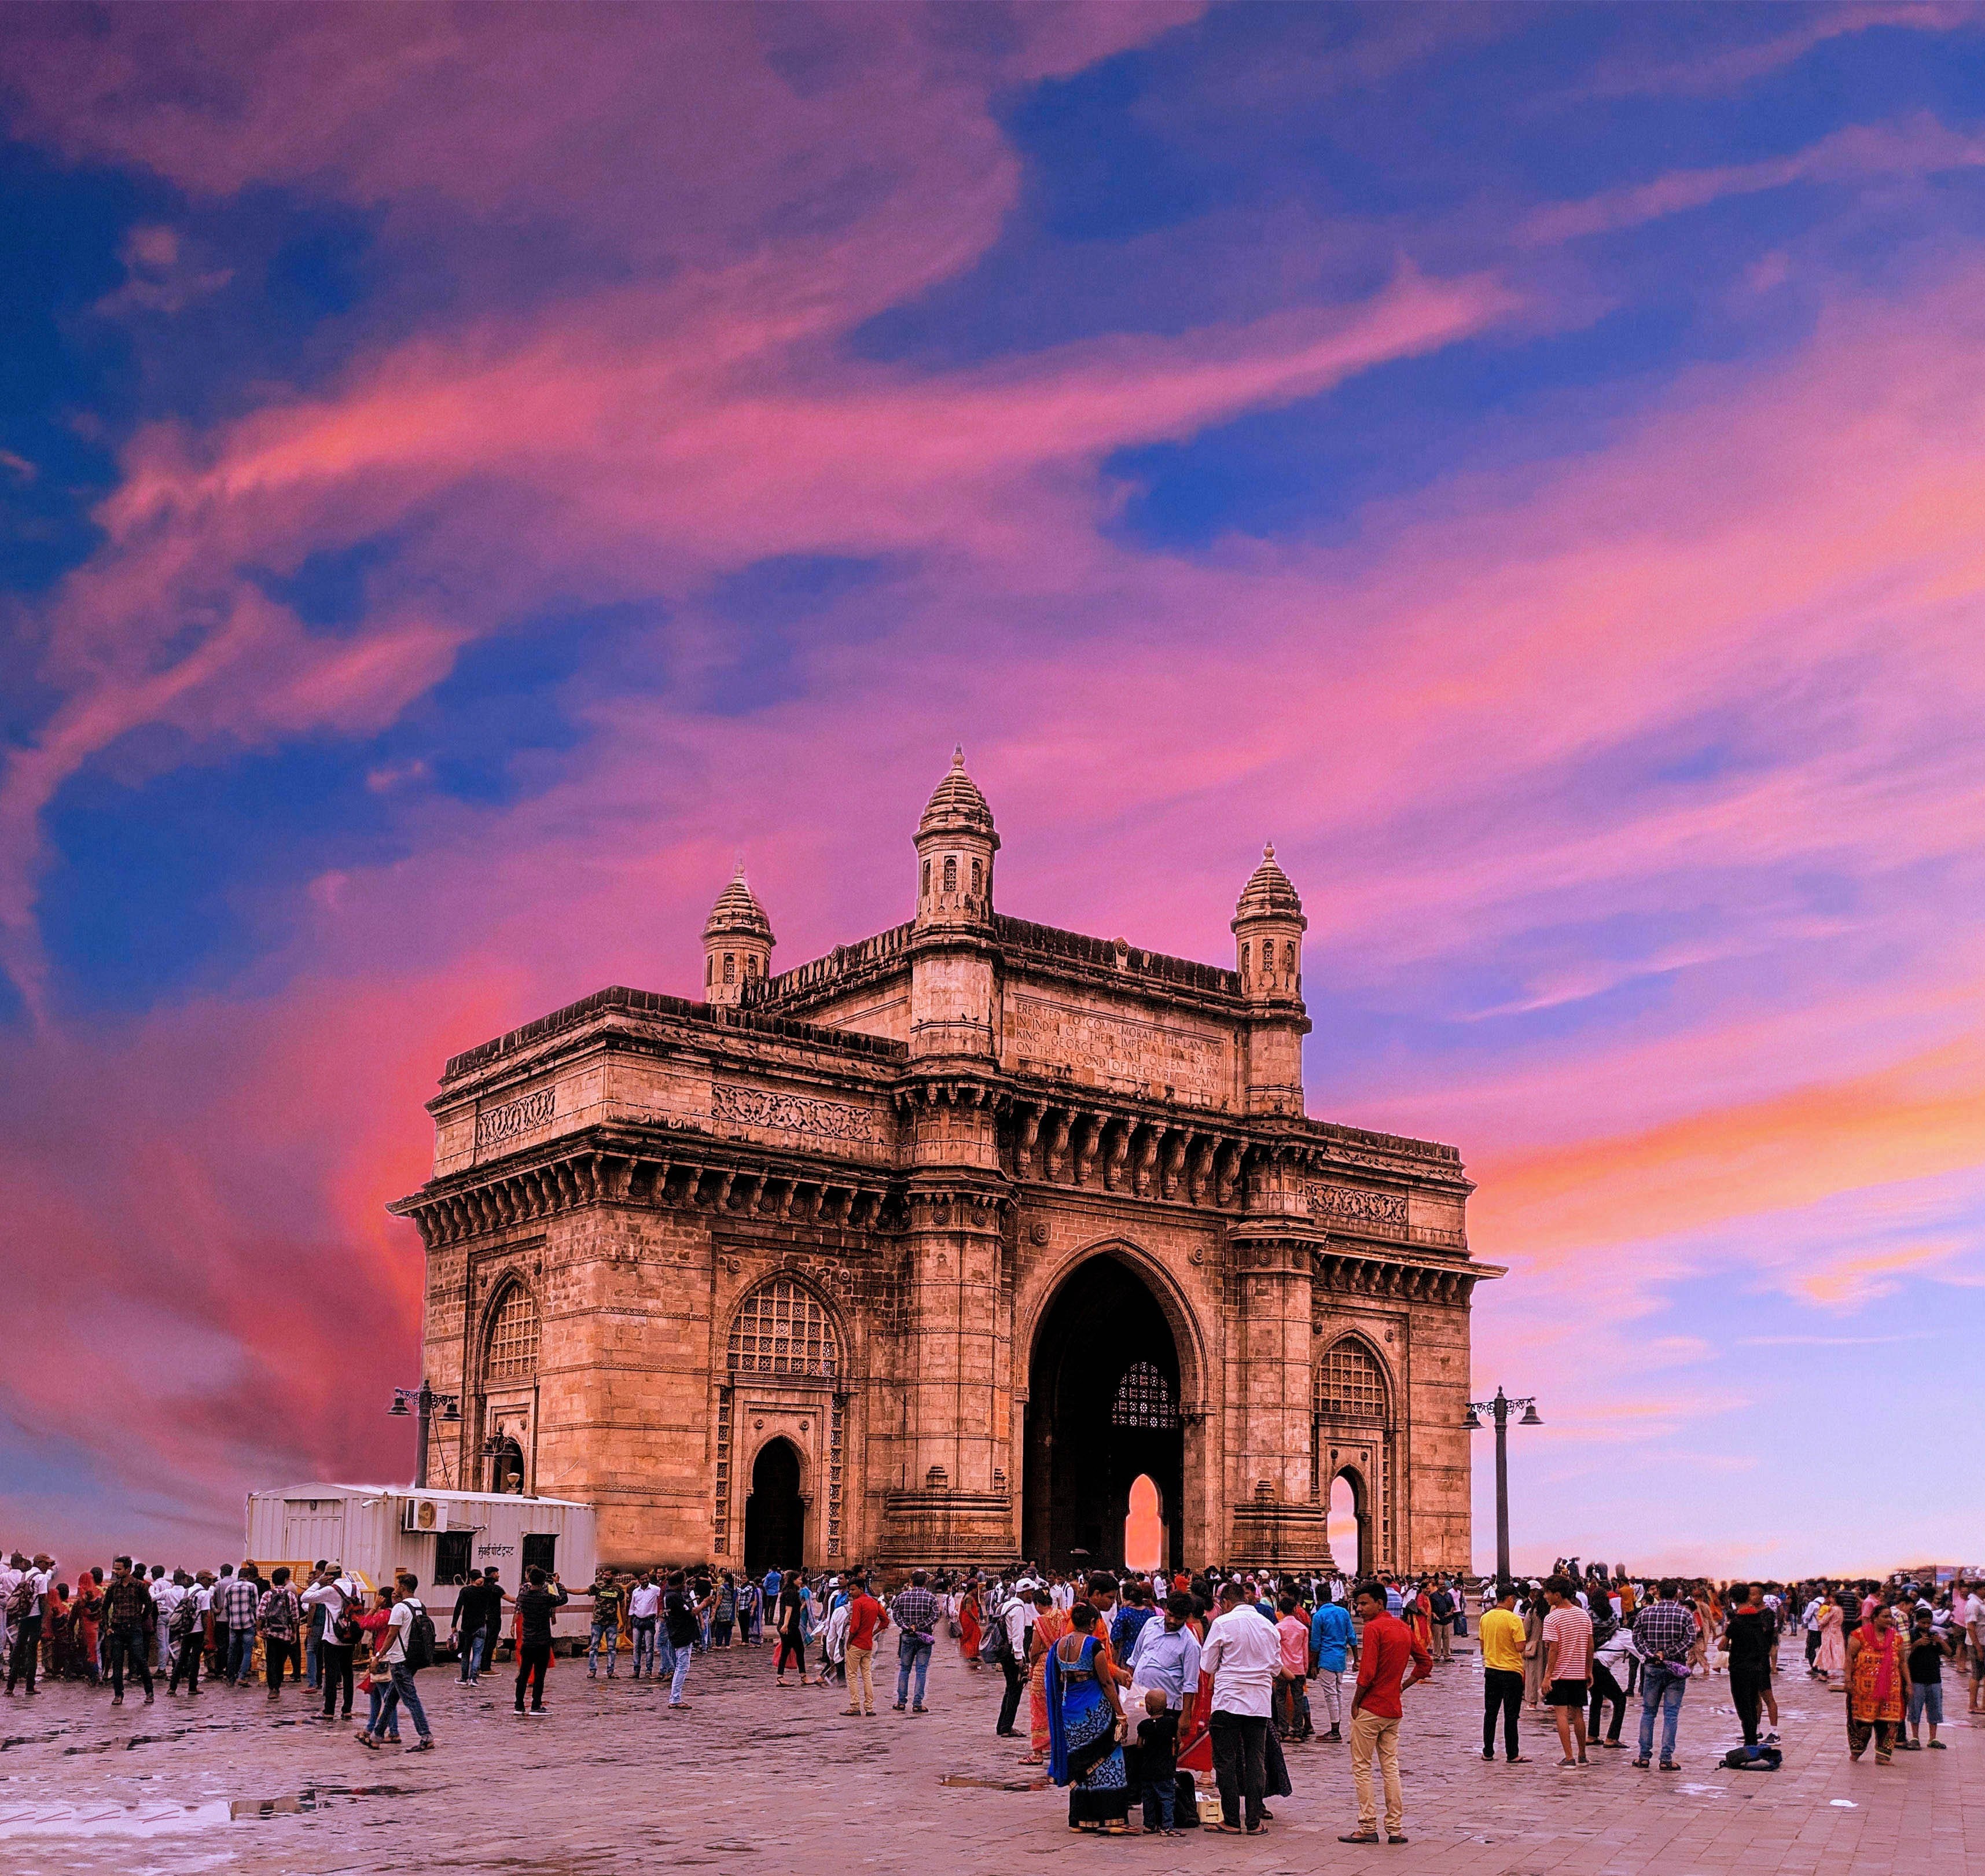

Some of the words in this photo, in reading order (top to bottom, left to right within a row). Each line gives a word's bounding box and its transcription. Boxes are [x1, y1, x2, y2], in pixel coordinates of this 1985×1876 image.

[1017, 1003, 1061, 1021] ERECTED
[1067, 1013, 1080, 1025] TO
[1086, 1018, 1158, 1042] COMMEMORATE
[1162, 1033, 1179, 1047] THE
[1183, 1038, 1223, 1057] LANDING
[1017, 1016, 1026, 1027] IN
[1032, 1018, 1059, 1035] INDIA
[1066, 1027, 1079, 1037] OF
[1089, 1031, 1113, 1044] THEIR
[1121, 1037, 1163, 1055] IMPERIAL
[1017, 1028, 1040, 1042] KING
[1052, 1036, 1095, 1054] GEORGE
[1123, 1051, 1141, 1062] AND
[1149, 1056, 1182, 1070] QUEEN
[1191, 1064, 1218, 1077] MARY
[1017, 1042, 1032, 1054] ON
[1041, 1046, 1056, 1059] THE
[1064, 1050, 1105, 1068] SECOND
[1112, 1060, 1125, 1071] OF
[1131, 1064, 1180, 1083] DECEMBER
[1188, 1075, 1218, 1090] MCMXI
[478, 1543, 491, 1559] मुंबई
[491, 1543, 502, 1556] पोर्ट
[502, 1546, 514, 1557] ट्रस्ट
